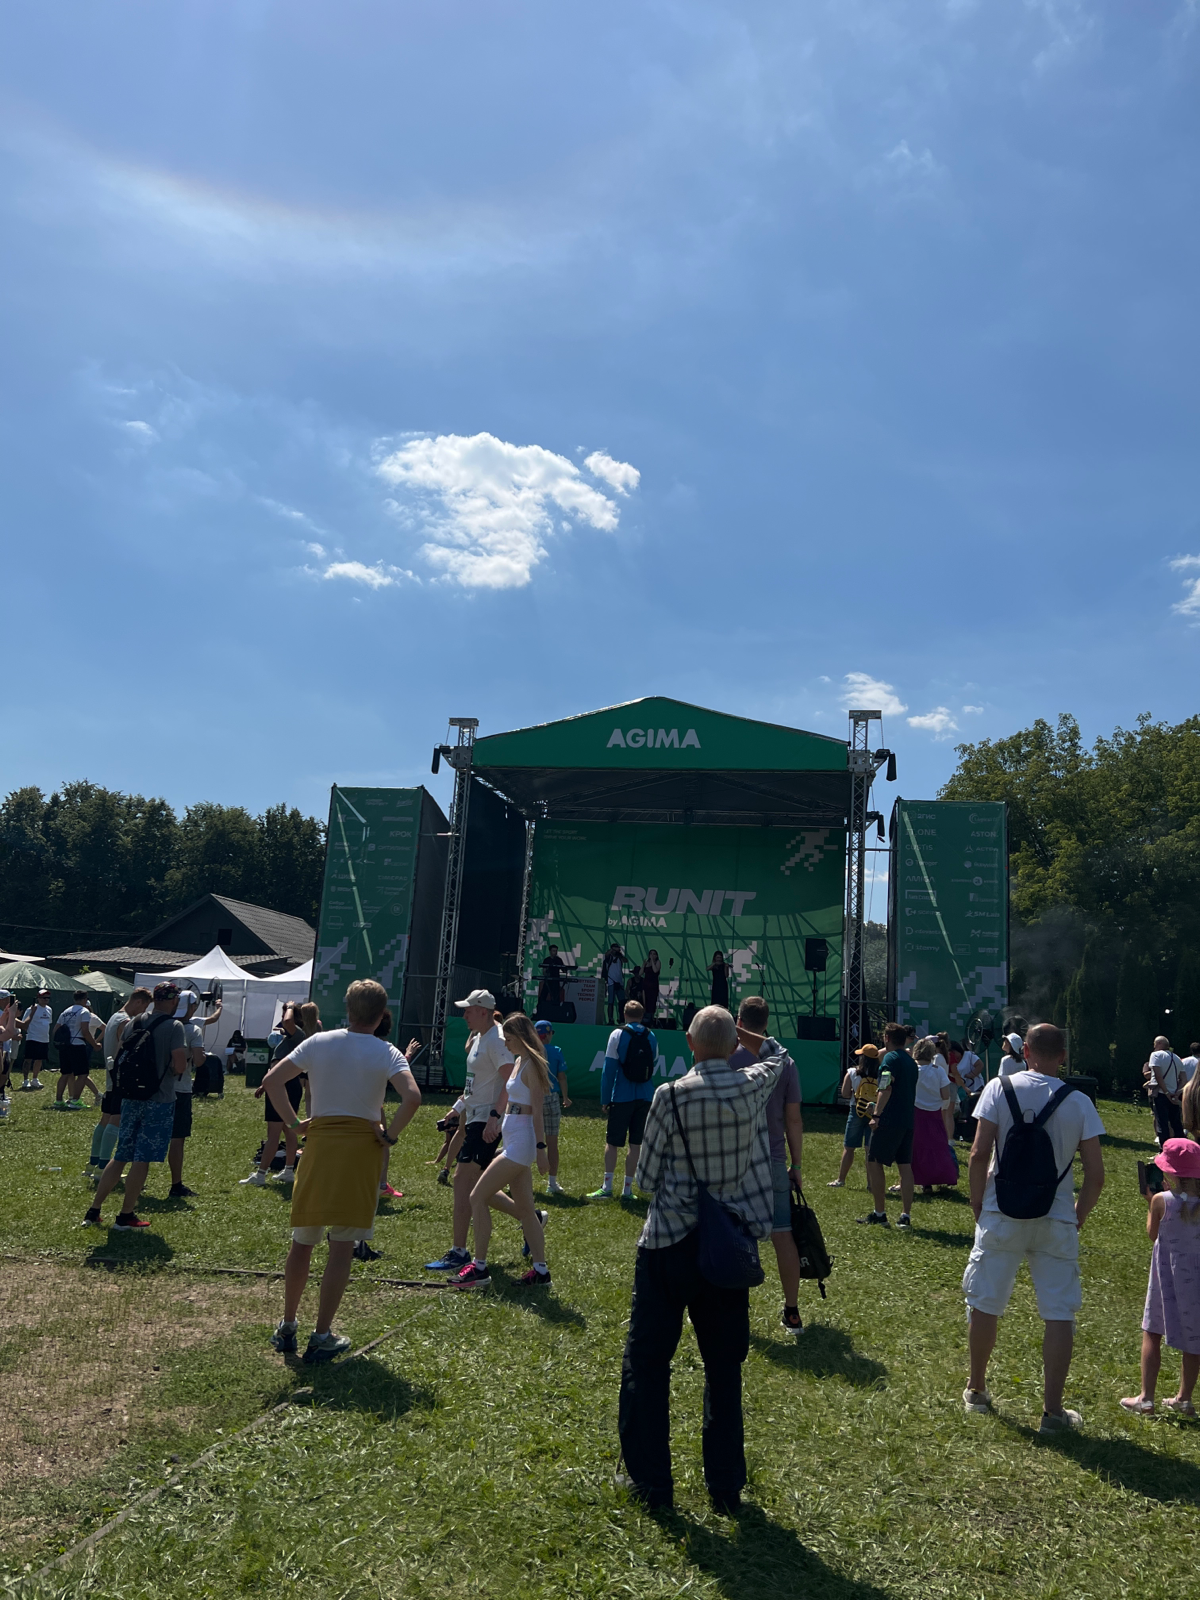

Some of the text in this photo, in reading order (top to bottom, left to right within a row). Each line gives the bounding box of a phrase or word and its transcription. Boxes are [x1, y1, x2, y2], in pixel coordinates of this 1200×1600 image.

[606, 728, 702, 749] AGIMA
[611, 886, 757, 917] RUNIT
[607, 917, 668, 928] by AGIMA
